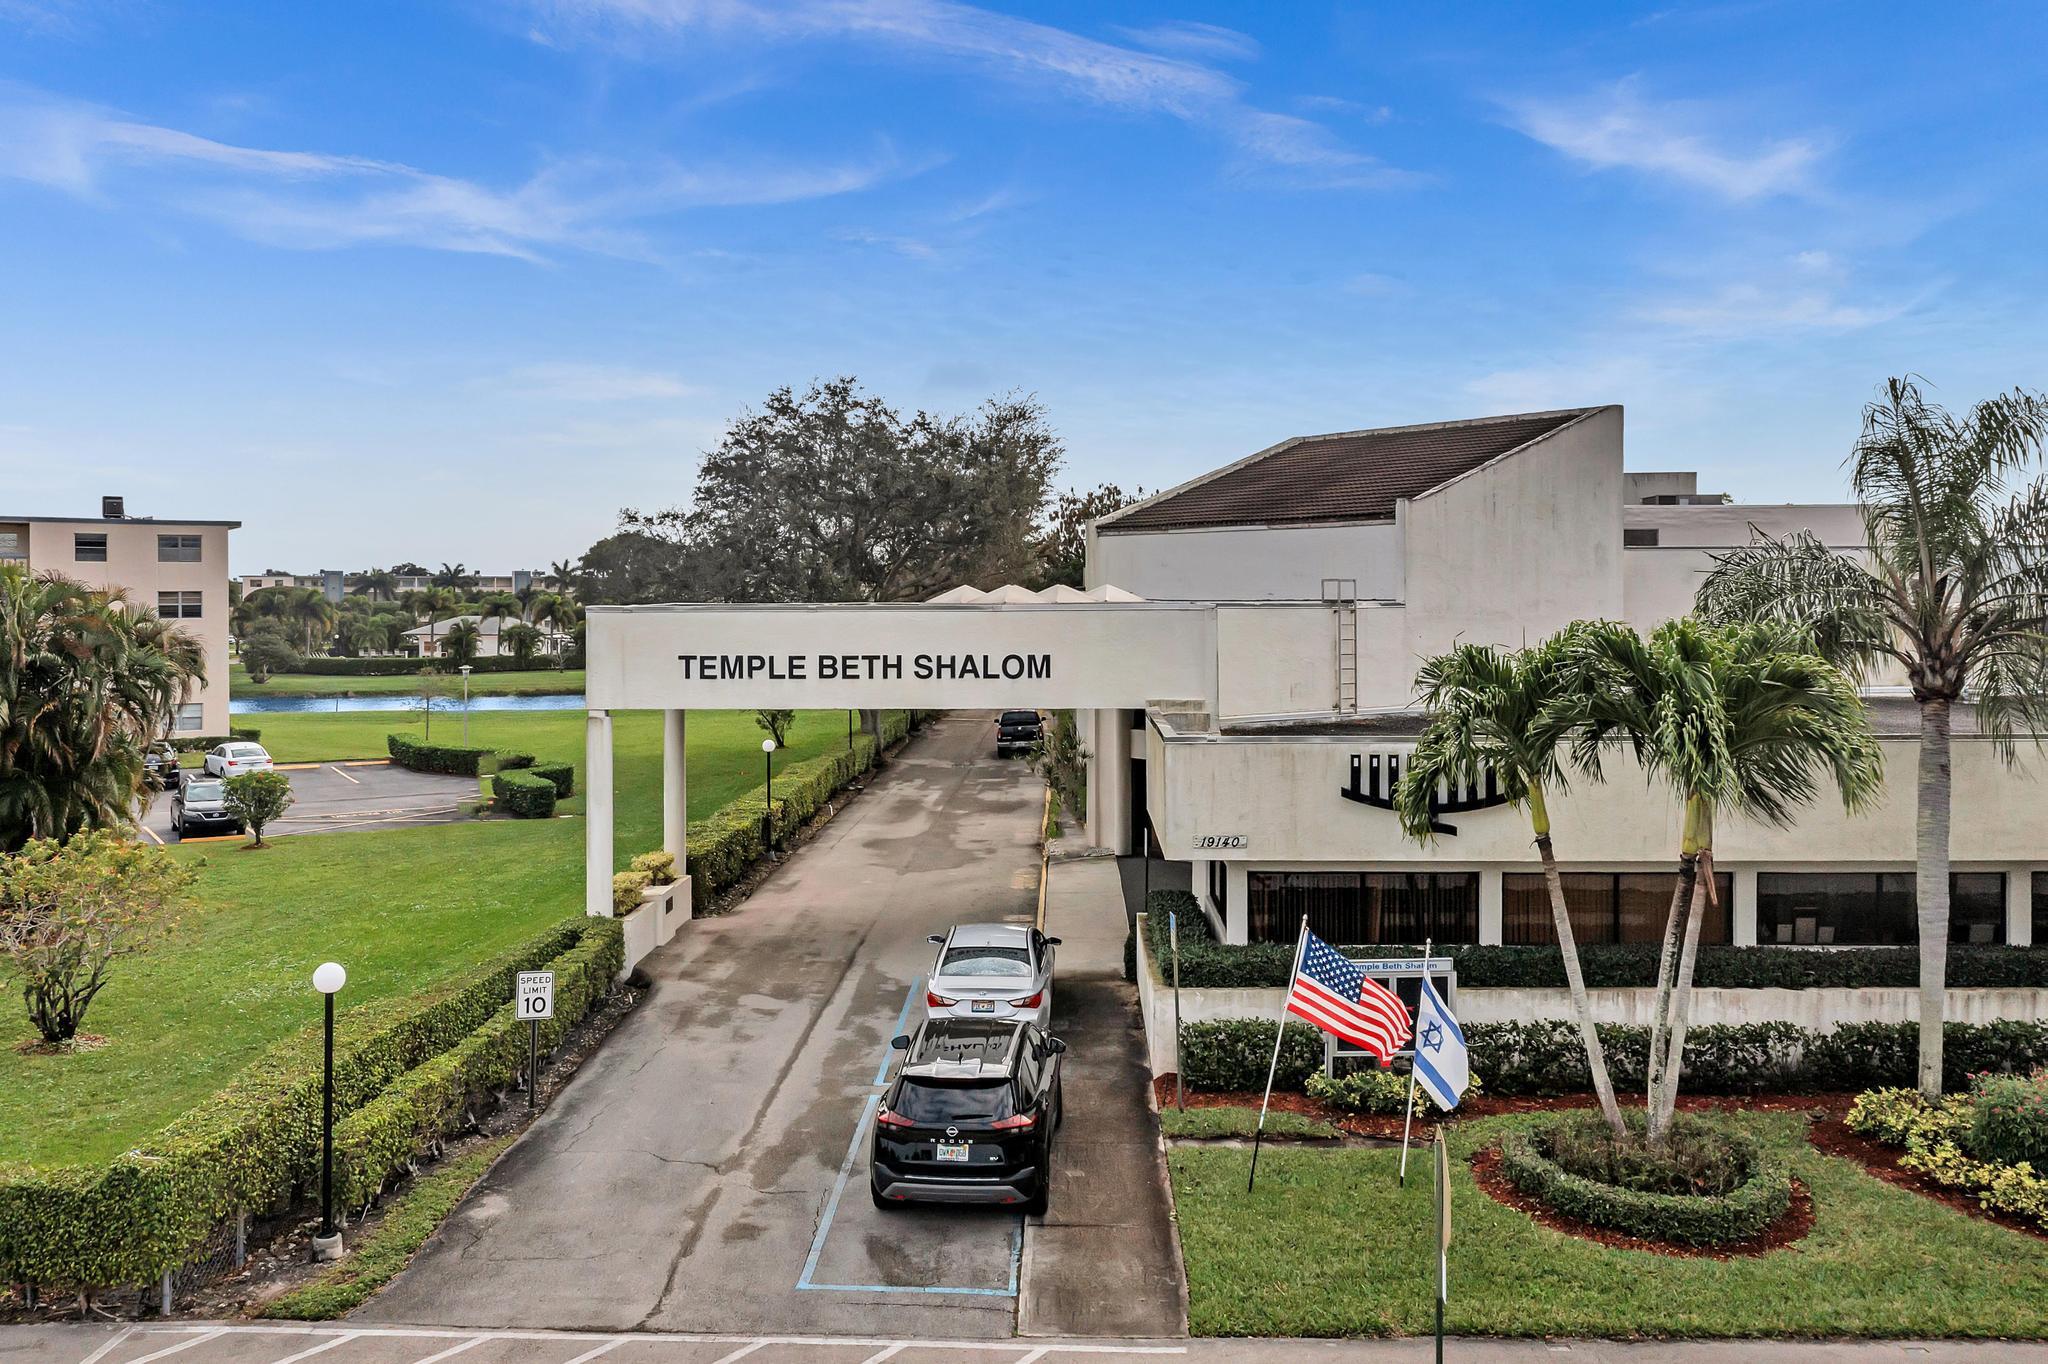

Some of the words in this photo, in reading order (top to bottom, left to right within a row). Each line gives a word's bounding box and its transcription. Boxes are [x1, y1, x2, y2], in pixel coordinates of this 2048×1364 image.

[678, 655, 806, 679] TEMPLE
[818, 654, 902, 679] BETH
[913, 653, 1052, 679] SHALOM
[1200, 836, 1240, 848] 19140
[1353, 963, 1380, 971] emple
[1382, 962, 1402, 970] Beth
[1405, 962, 1438, 970] Shalm
[520, 976, 552, 984] SPEED
[523, 986, 547, 994] LIMIT
[524, 996, 546, 1014] 10
